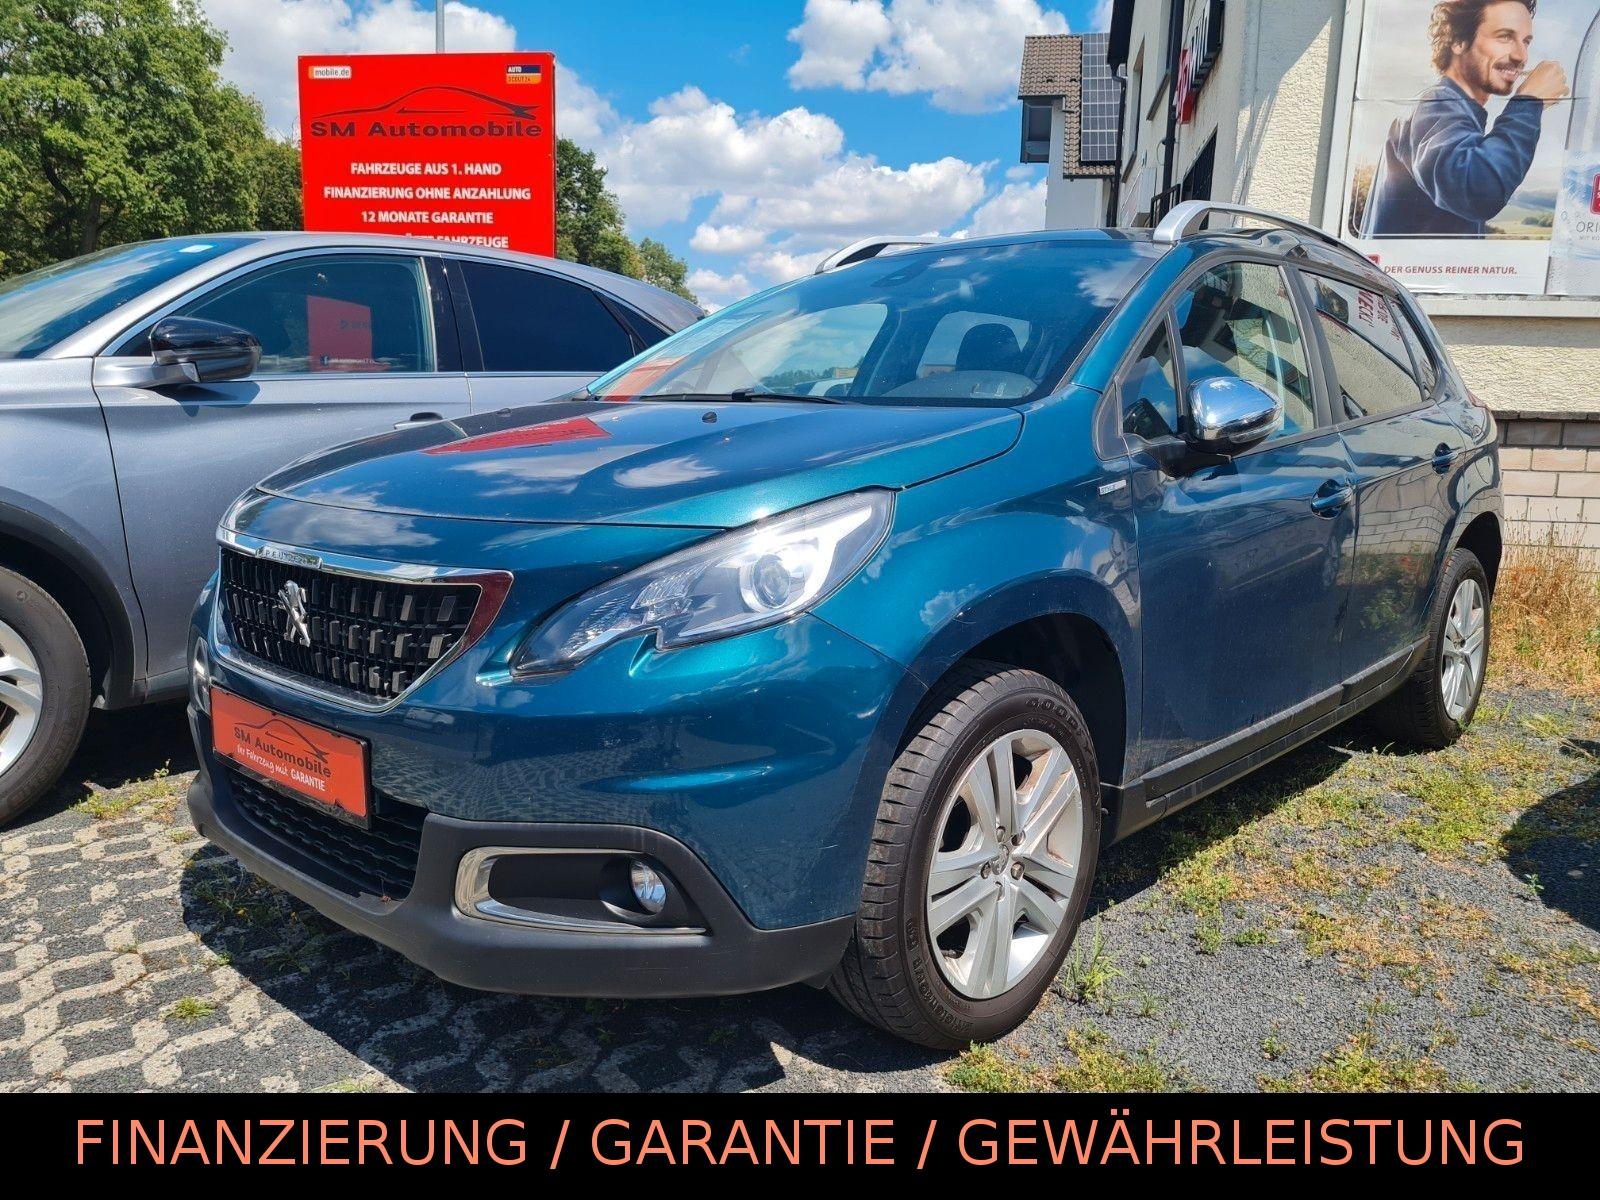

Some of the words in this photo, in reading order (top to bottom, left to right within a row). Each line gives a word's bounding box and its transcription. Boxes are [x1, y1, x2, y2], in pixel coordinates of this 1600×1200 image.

[315, 67, 350, 77] mobile.de
[508, 75, 531, 83] SCOUT24
[311, 121, 356, 137] SM
[368, 120, 542, 137] Automobile
[350, 163, 422, 175] FAHRZEUGE
[424, 163, 449, 175] AUS
[451, 163, 463, 175] 1.
[464, 163, 502, 175] HAND
[323, 186, 414, 199] FINANZIERUNG
[415, 187, 451, 199] OHNE
[453, 187, 532, 200] ANZAHLUNG
[361, 211, 376, 223] 12
[377, 211, 430, 223] MONATE
[431, 212, 494, 224] GARANTIE
[1576, 221, 1600, 233] ORI
[437, 236, 509, 248] HRZEUGE
[1384, 265, 1404, 275] DER
[1405, 265, 1443, 275] GENUSS
[1445, 265, 1480, 275] REINER
[1481, 265, 1517, 275] NATUR.
[234, 726, 251, 745] SM
[254, 737, 332, 778] Automobile
[290, 768, 326, 792] GARANTIE
